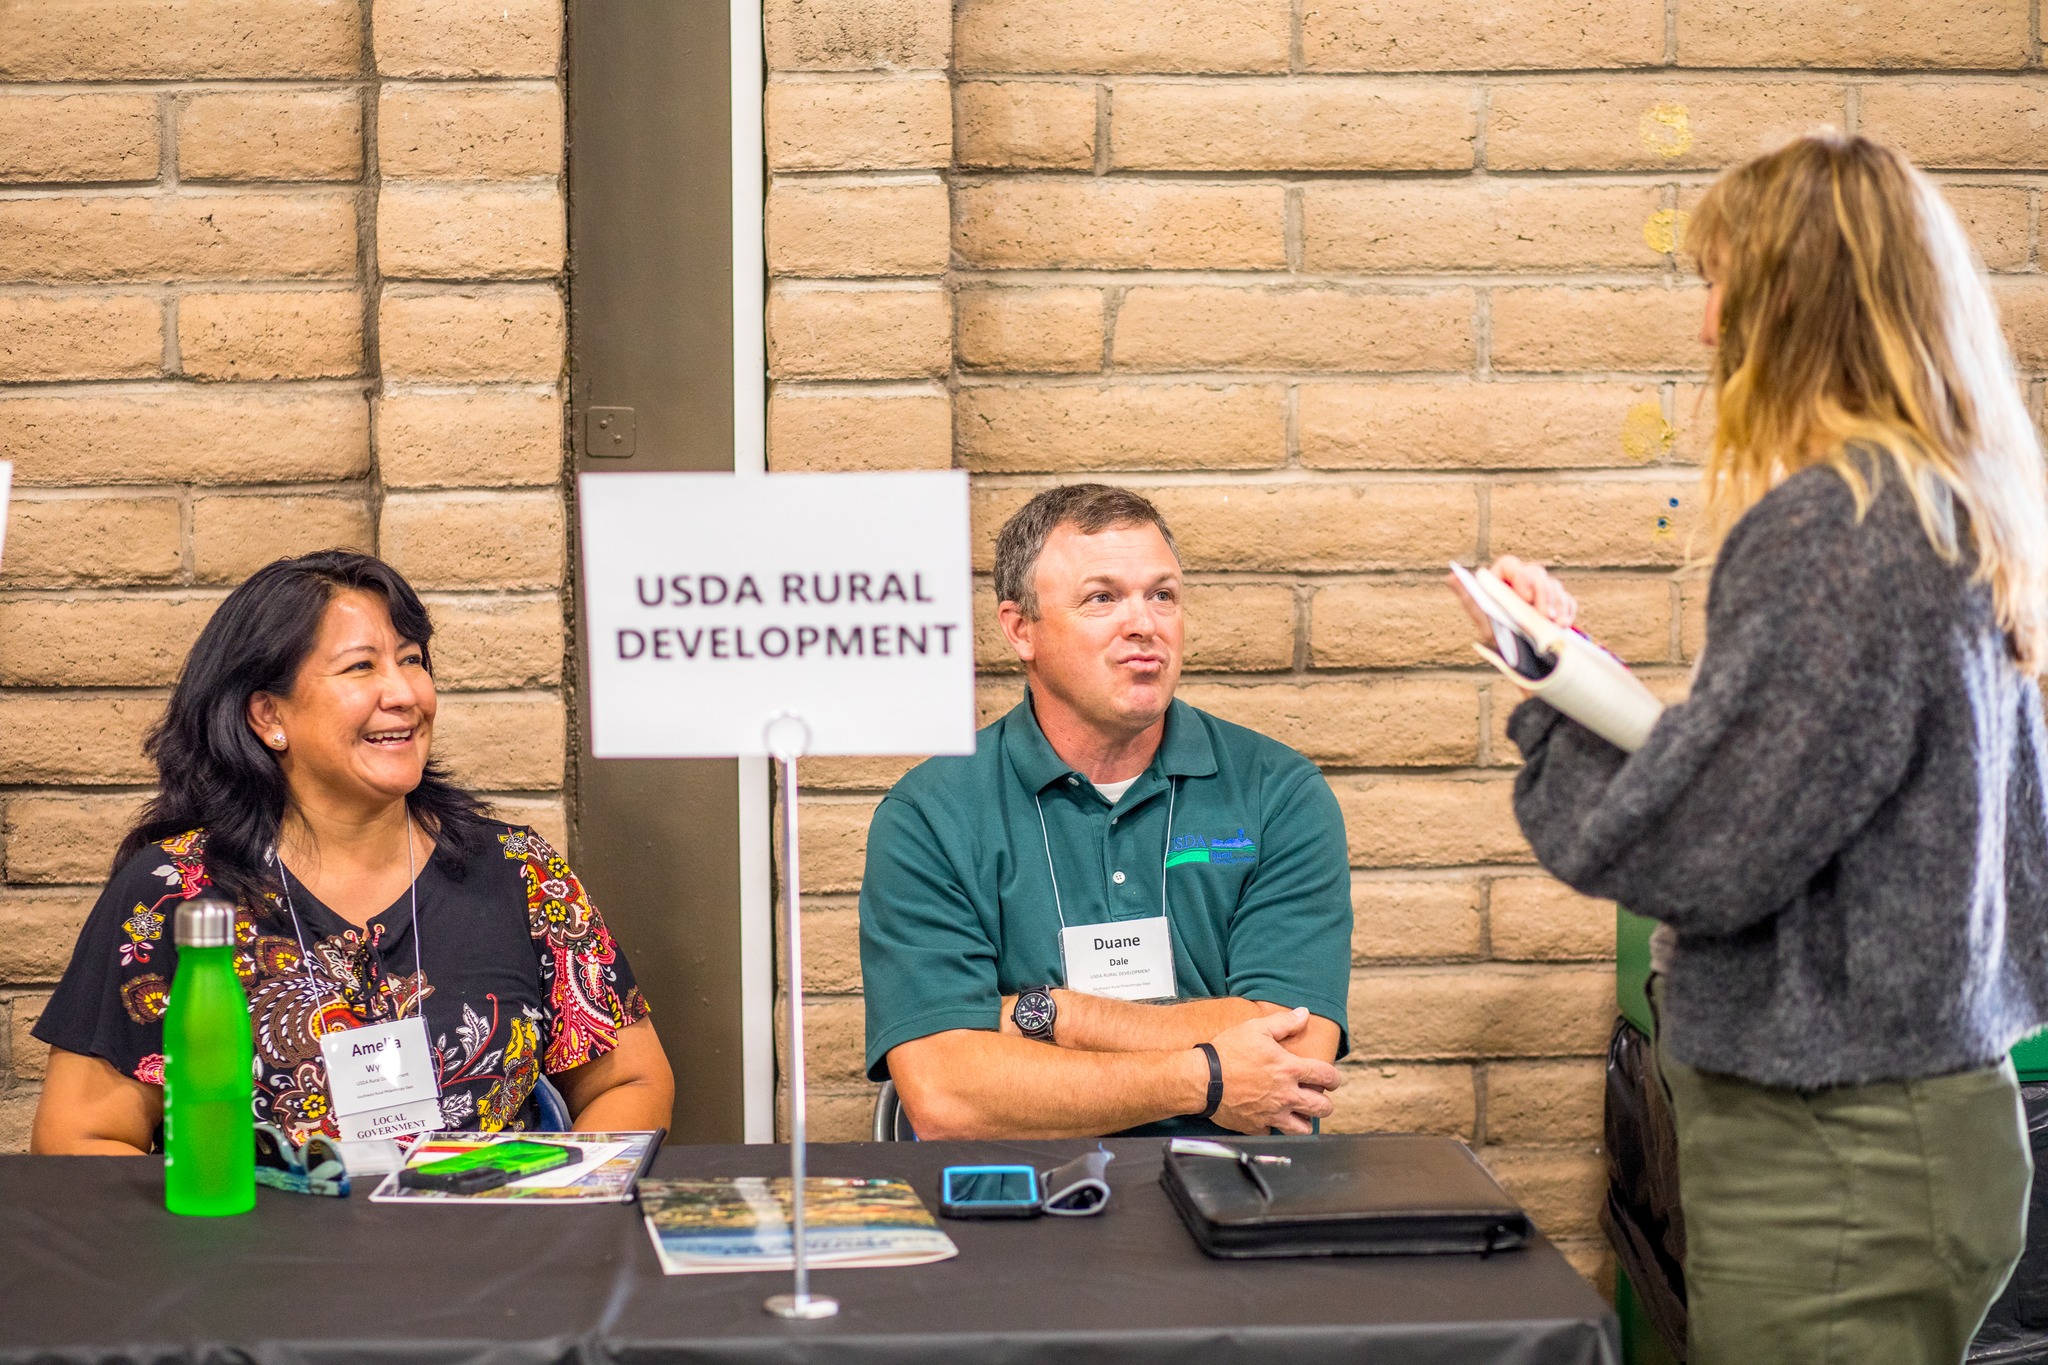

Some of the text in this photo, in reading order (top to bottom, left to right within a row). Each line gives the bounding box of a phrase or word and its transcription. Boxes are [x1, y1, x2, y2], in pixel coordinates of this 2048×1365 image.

[636, 570, 933, 607] USDA RURAL
[616, 623, 957, 661] DEVELOPMENT
[1094, 936, 1140, 950] Duane
[1109, 957, 1129, 967] Dale
[352, 1037, 402, 1057] Amela
[372, 1113, 407, 1126] LOCAL
[357, 1120, 426, 1139] GOVERNMENT
